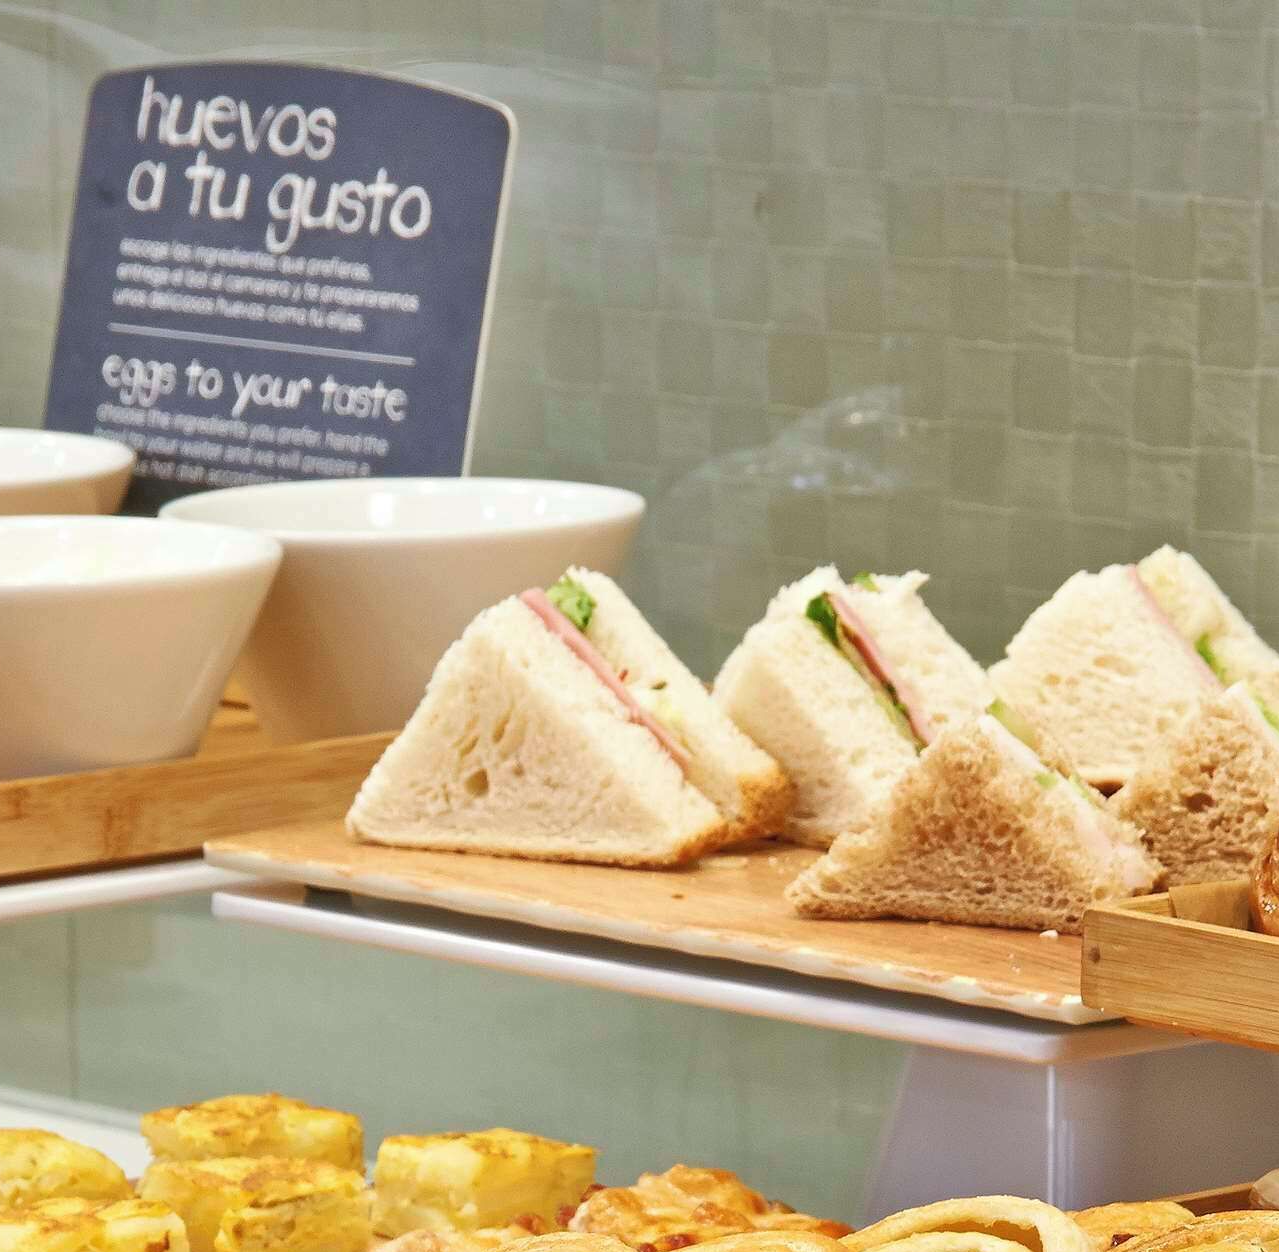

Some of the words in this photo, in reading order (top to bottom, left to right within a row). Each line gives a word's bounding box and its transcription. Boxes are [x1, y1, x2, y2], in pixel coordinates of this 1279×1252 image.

[136, 75, 337, 160] huevos
[126, 159, 167, 212] a
[185, 150, 251, 221] tu
[265, 167, 433, 254] gusto
[102, 354, 177, 408] eggs
[185, 358, 223, 399] to
[231, 371, 312, 418] your
[320, 374, 408, 422] taste
